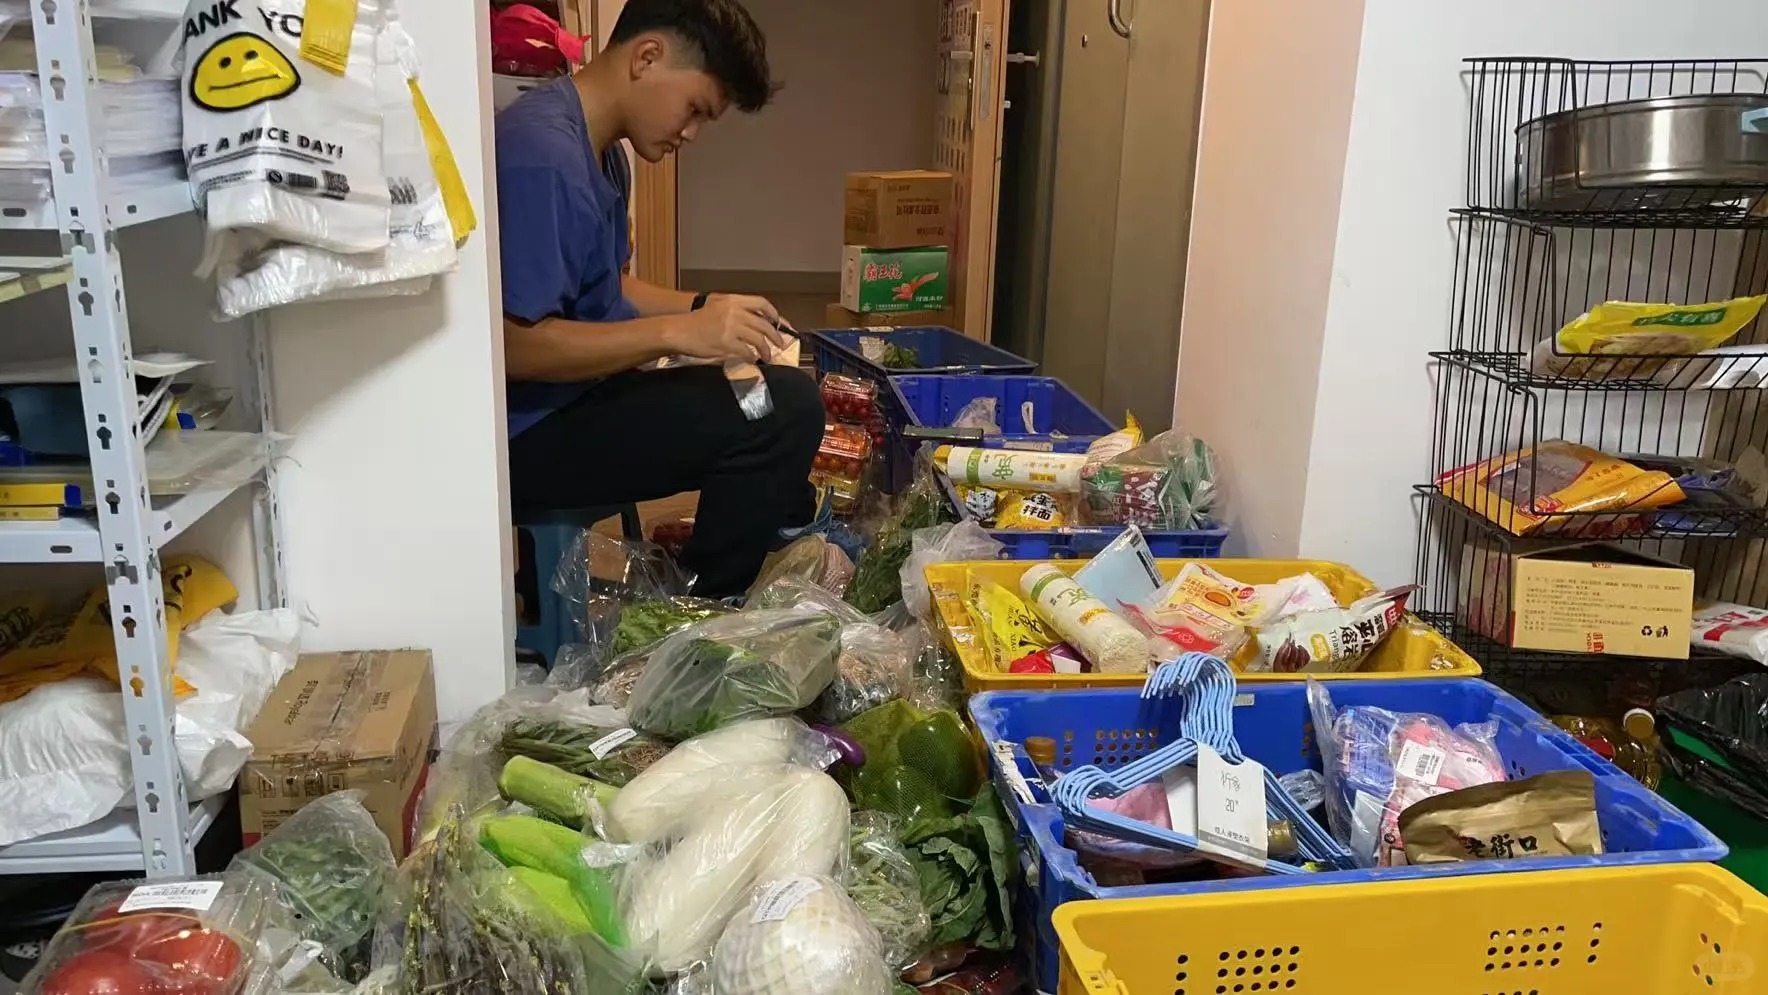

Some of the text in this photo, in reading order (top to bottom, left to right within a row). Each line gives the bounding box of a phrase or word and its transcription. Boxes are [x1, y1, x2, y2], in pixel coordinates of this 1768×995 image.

[216, 137, 230, 153] A
[239, 126, 290, 147] NICE
[297, 134, 344, 159] DAY!
[1022, 503, 1053, 522] 拌面
